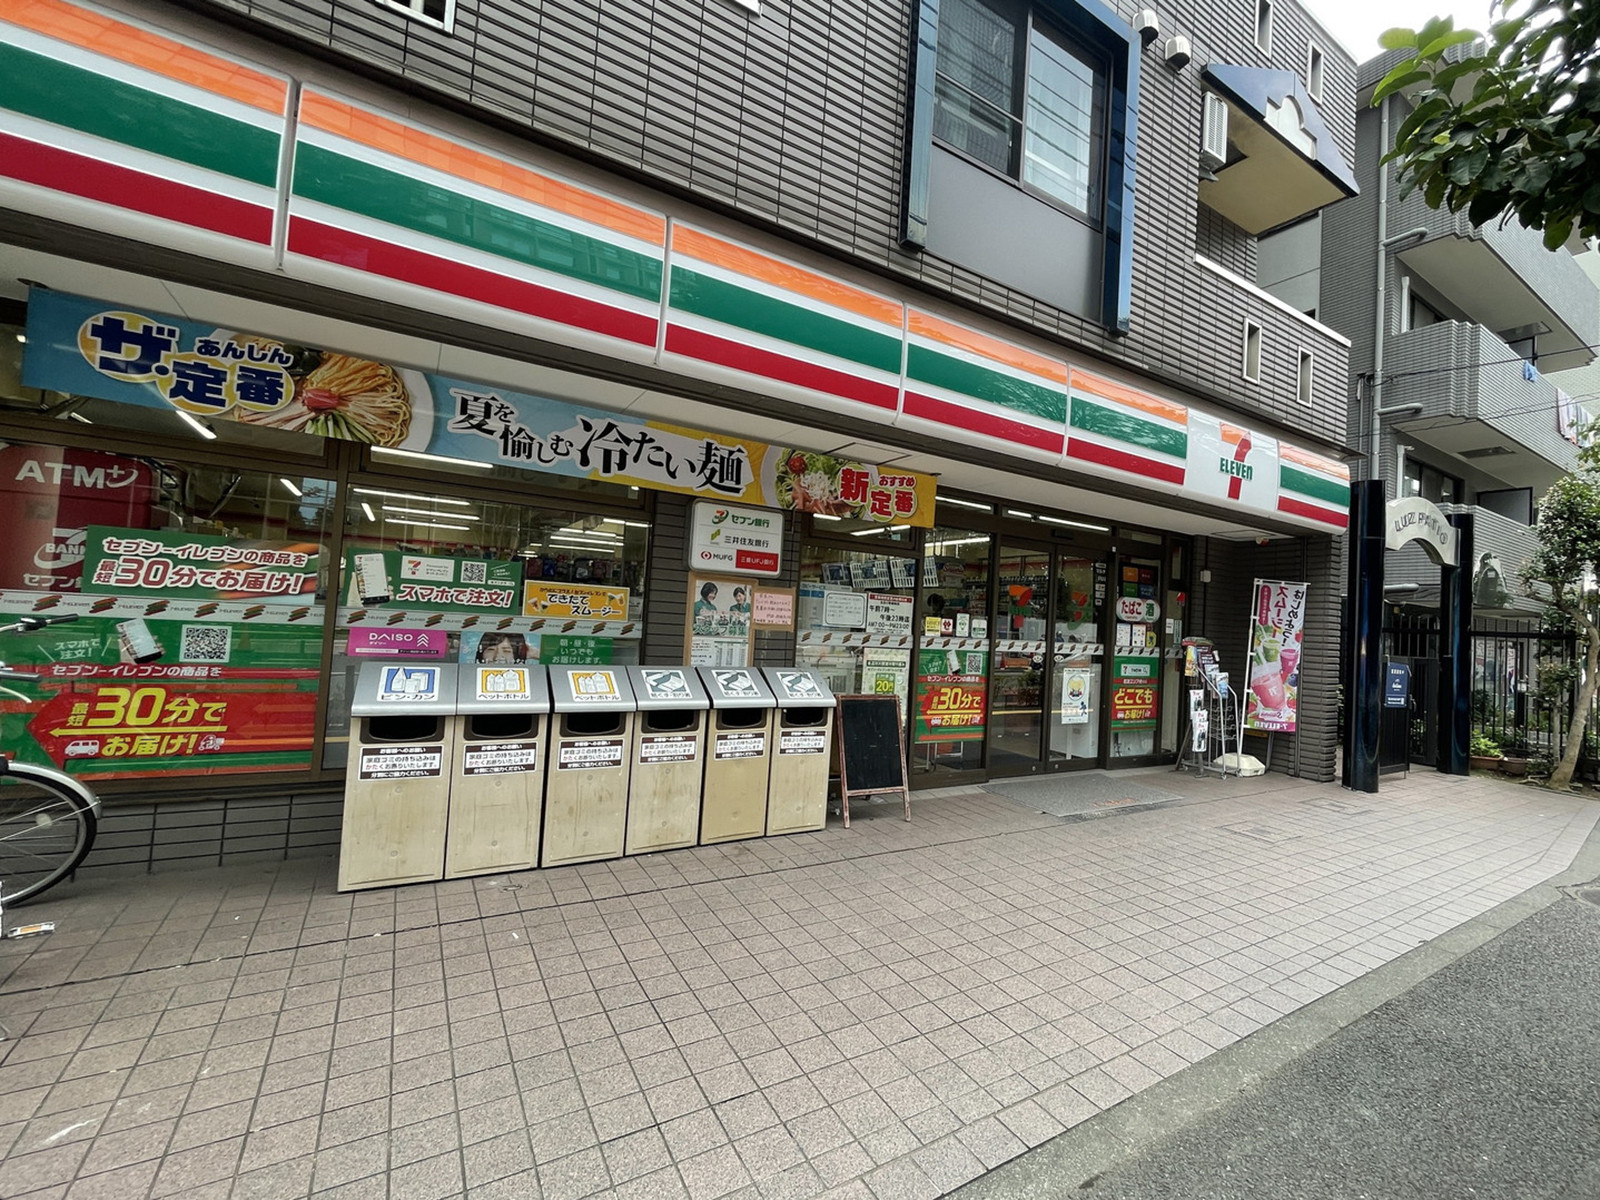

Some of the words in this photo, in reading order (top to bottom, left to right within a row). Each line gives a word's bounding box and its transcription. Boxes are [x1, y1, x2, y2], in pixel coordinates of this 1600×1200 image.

[195, 337, 293, 367] あんしん
[879, 475, 915, 487] おすすめ
[731, 514, 770, 528] セブン銀行
[724, 535, 769, 548] 三井住友銀行
[713, 553, 733, 561] MUFG
[547, 593, 589, 606] できたて
[571, 605, 622, 616] スムージー
[1121, 600, 1142, 615] たばこ
[368, 632, 414, 642] DAISO
[560, 648, 594, 656] いつでも
[1114, 688, 1153, 705] どこでも
